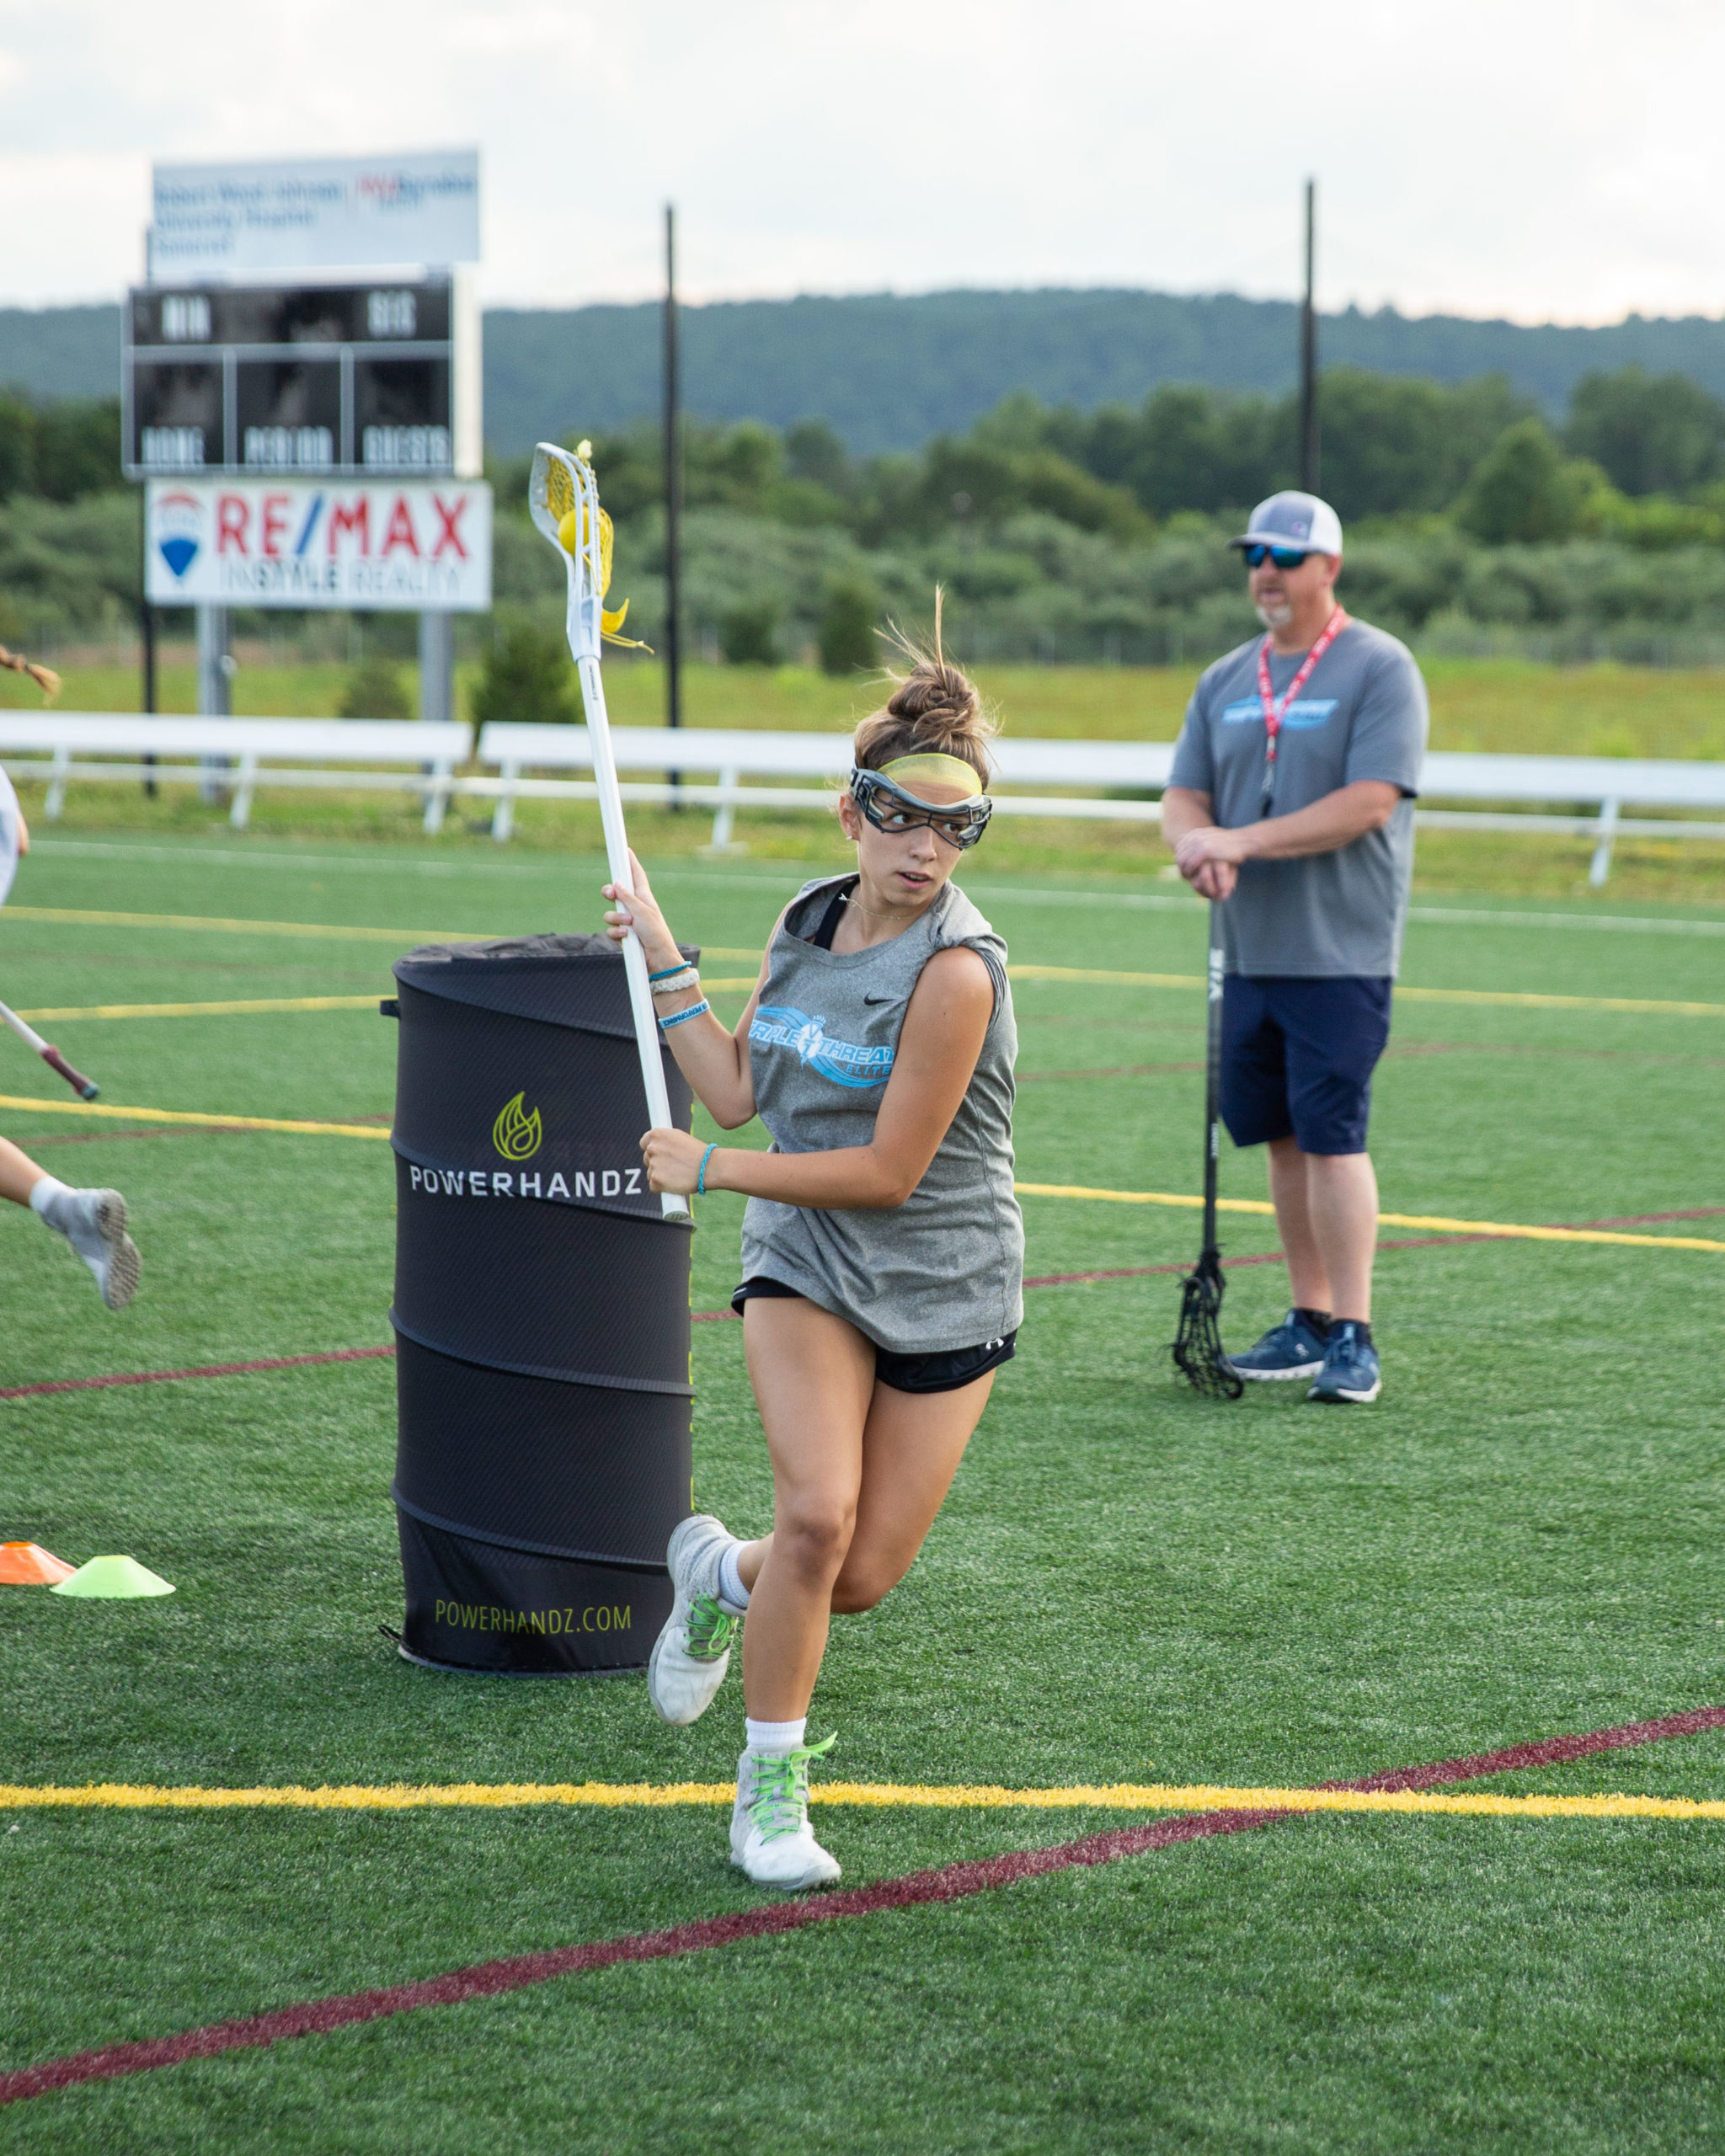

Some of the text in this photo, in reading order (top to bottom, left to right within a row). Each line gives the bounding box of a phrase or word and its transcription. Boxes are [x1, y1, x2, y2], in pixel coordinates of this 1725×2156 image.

[216, 489, 469, 559] RE/MAX
[845, 1064, 891, 1075] ELITE
[409, 1166, 642, 1198] POWERHANDZ
[435, 1598, 632, 1635] POWERHANDZ.COM
